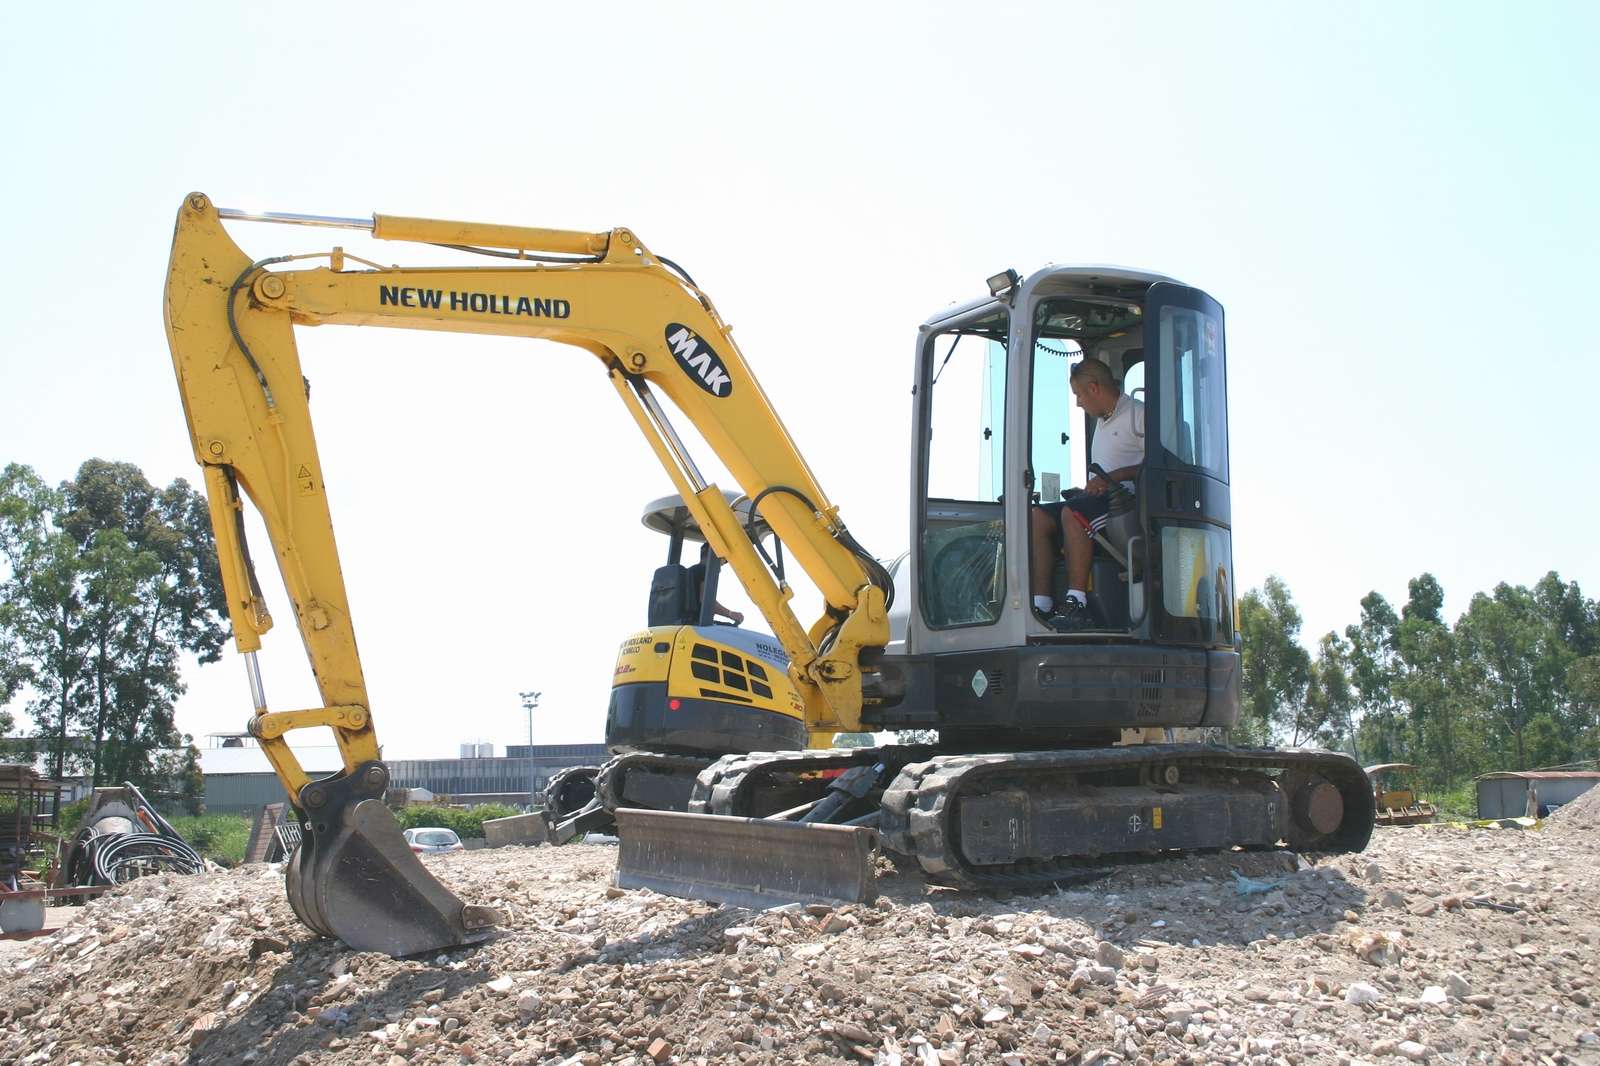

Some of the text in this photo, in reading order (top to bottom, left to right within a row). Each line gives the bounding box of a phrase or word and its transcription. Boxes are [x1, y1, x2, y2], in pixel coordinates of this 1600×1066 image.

[380, 285, 571, 319] NEW HOLLAND
[667, 327, 731, 396] MAK
